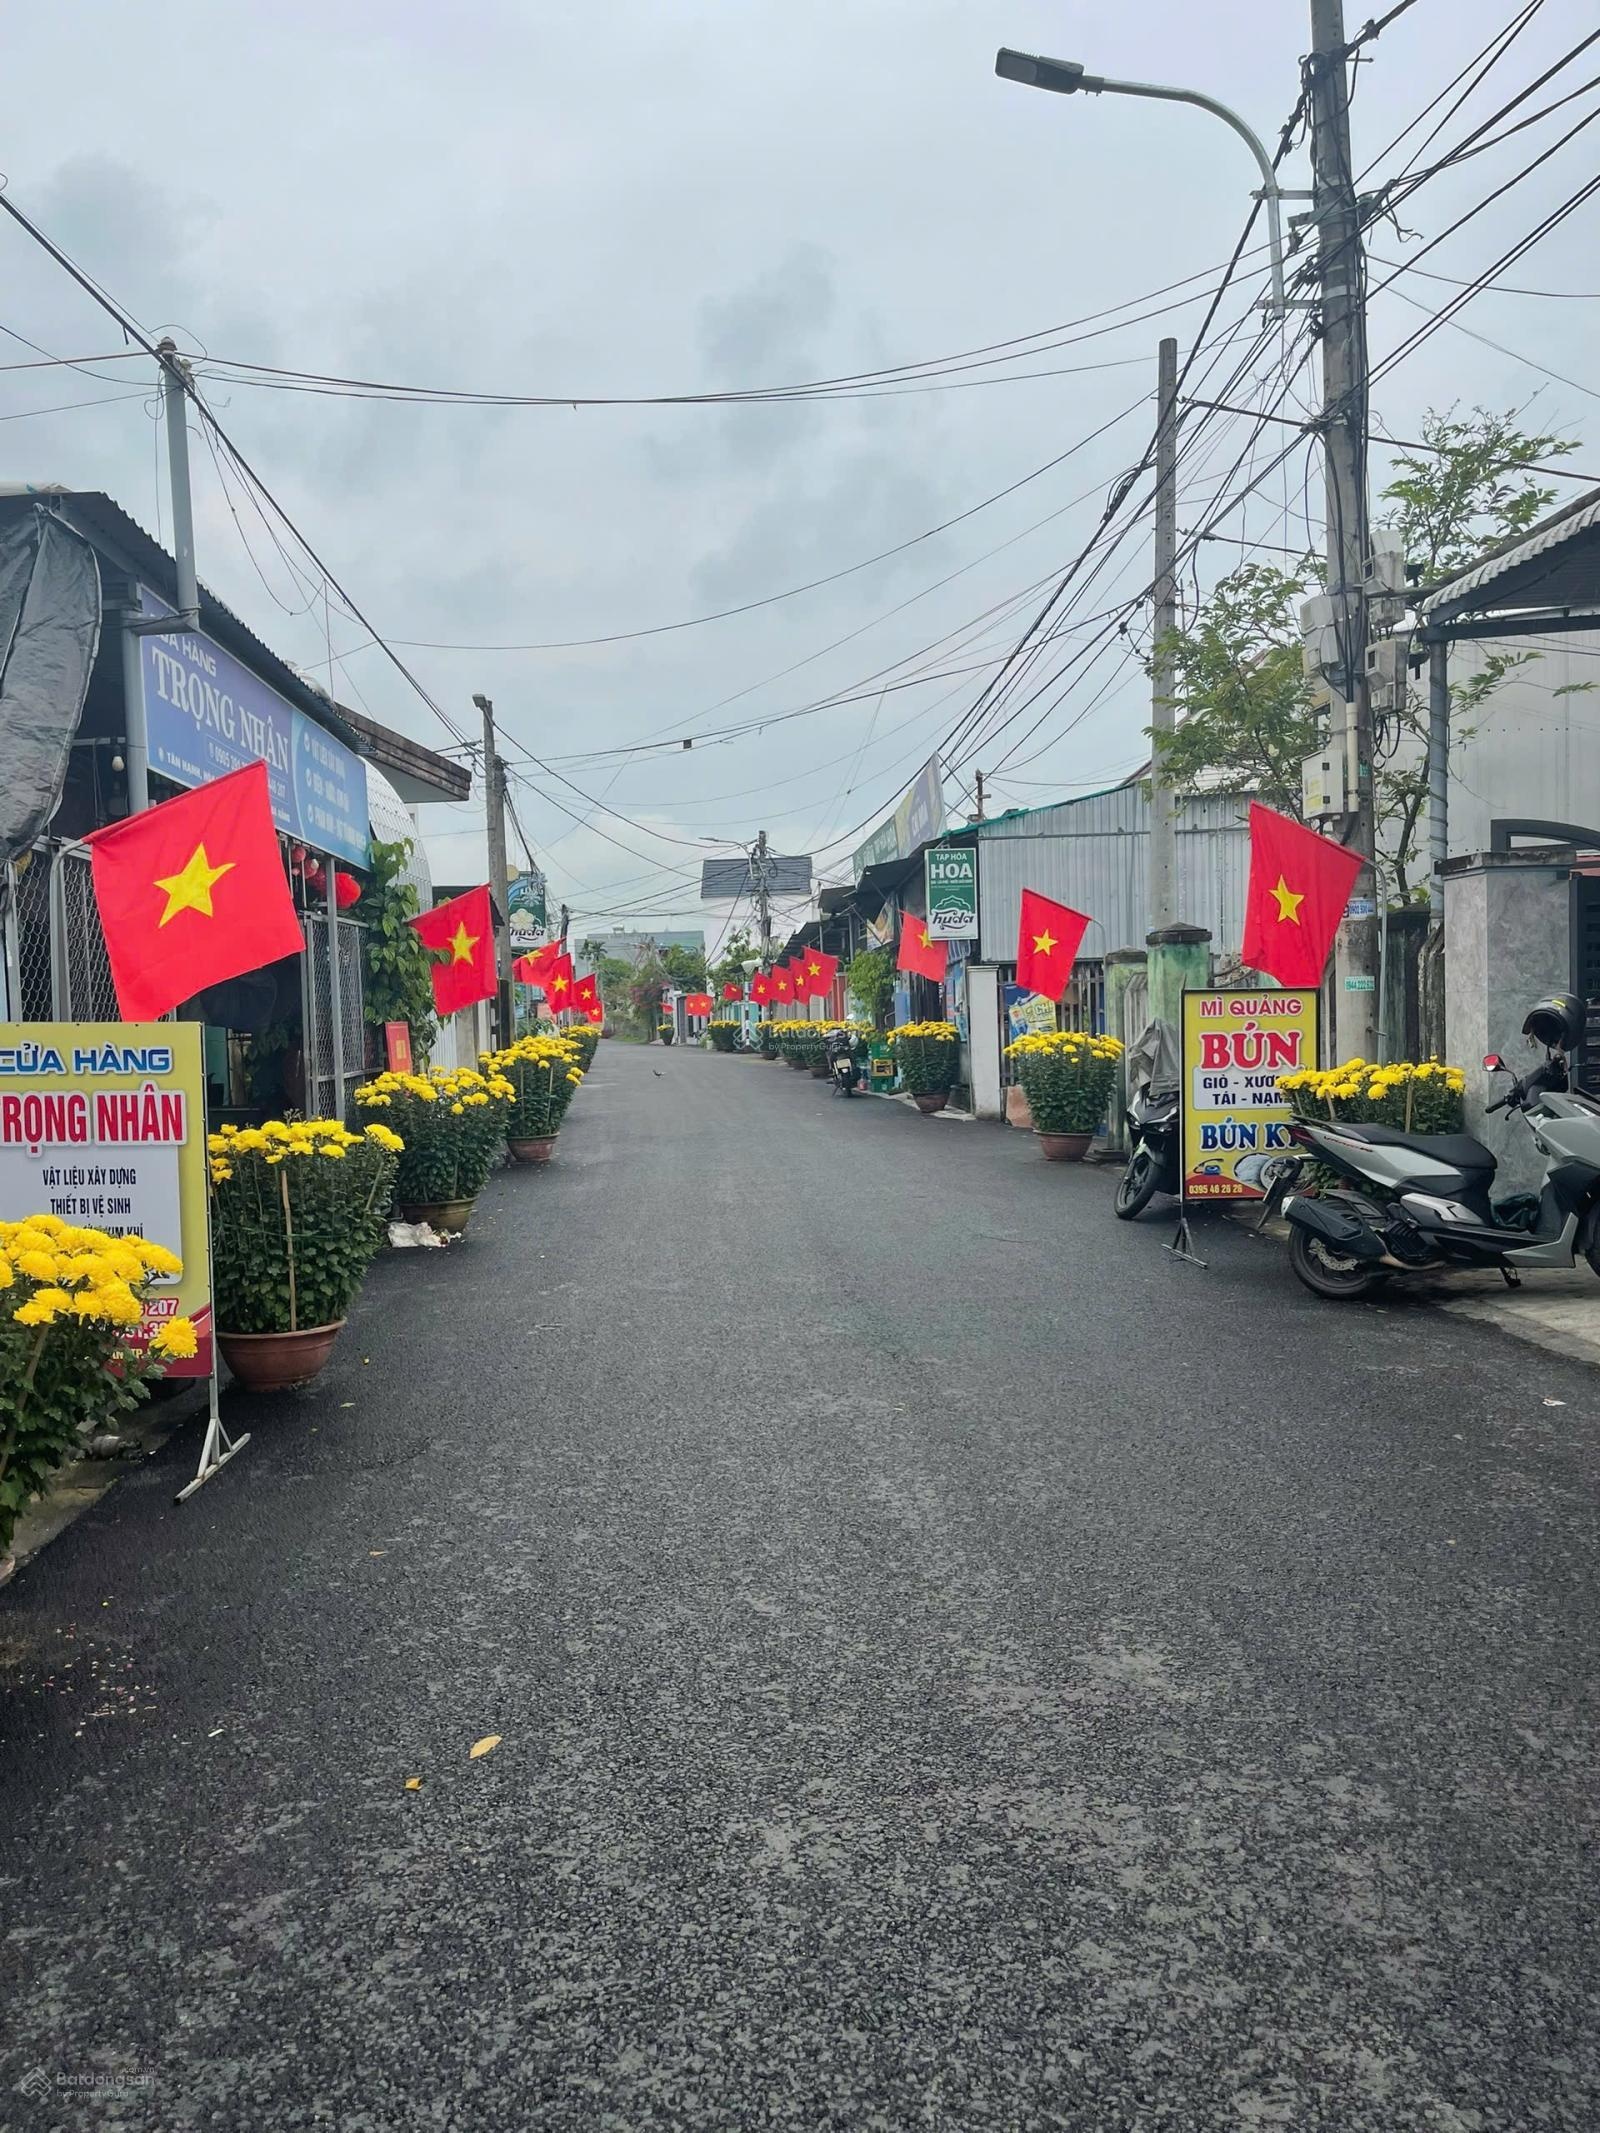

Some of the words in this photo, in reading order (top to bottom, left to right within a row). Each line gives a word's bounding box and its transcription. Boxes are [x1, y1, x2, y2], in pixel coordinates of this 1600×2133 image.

[182, 637, 217, 677] HÀNG
[151, 645, 236, 740] TRỌNG
[239, 705, 289, 774] NHÂN
[935, 853, 949, 862] TẠP
[930, 863, 973, 879] HOA
[1201, 996, 1222, 1016] MÌ
[1230, 994, 1302, 1015] QUẢNG
[1201, 1022, 1300, 1069] BÚN
[75, 1045, 170, 1072] HÀNG
[1203, 1074, 1228, 1089] GIÒ
[1213, 1091, 1236, 1105] TÁI
[3, 1094, 87, 1153] RỌNG
[97, 1084, 183, 1142] NHÂN
[1201, 1117, 1258, 1149] BÚN
[43, 1166, 60, 1189] VẬT
[64, 1166, 84, 1189] LIỆU
[88, 1165, 106, 1185] XÂY
[109, 1167, 136, 1188] DỰNG
[1189, 1185, 1208, 1194] 0395
[50, 1193, 77, 1214] THIẾT
[80, 1198, 90, 1218] BỊ
[92, 1194, 104, 1218] VỆ
[107, 1198, 131, 1214] SINH
[147, 1298, 178, 1316] 207
